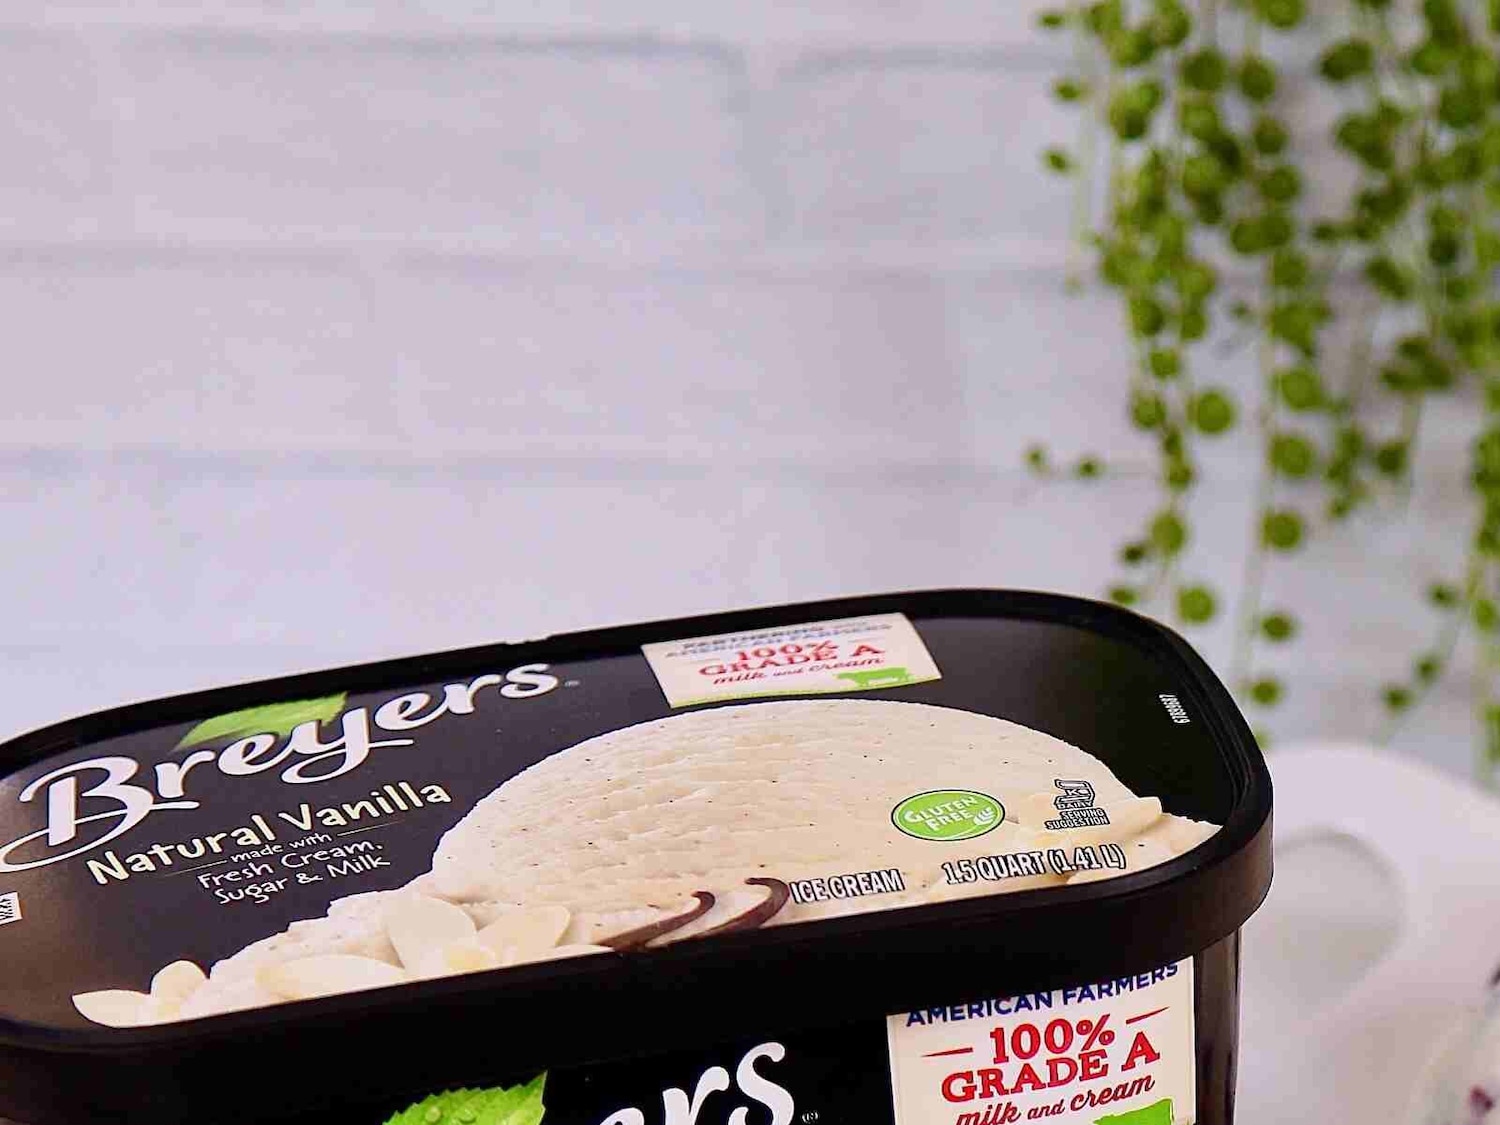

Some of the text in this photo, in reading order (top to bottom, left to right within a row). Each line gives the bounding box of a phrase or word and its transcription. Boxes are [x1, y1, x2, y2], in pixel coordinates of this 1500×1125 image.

[699, 643, 886, 676] GRADE A
[737, 639, 839, 661] 100%
[713, 671, 767, 685] milk
[809, 657, 885, 674] cream
[0, 662, 558, 873] Breyers
[903, 795, 978, 824] GLUTEN
[924, 810, 974, 831] FREE
[1057, 801, 1092, 810] DAIRY
[1061, 809, 1104, 820] SERVING
[86, 781, 452, 885] Natural Vanilla
[1046, 816, 1109, 829] SUGGESTION
[231, 832, 332, 864] made with
[942, 844, 1126, 885] 1.5 QUART (1.41 L)
[198, 862, 274, 889] Fresh
[214, 855, 391, 905] Sugar & Milk
[791, 869, 905, 903] ICE CREAM
[906, 961, 1178, 1027] AMERICAN FARMERS
[990, 1014, 1115, 1065] 100%
[941, 1031, 1160, 1103] GRADE A
[1027, 1098, 1066, 1121] and
[1070, 1074, 1156, 1112] cream
